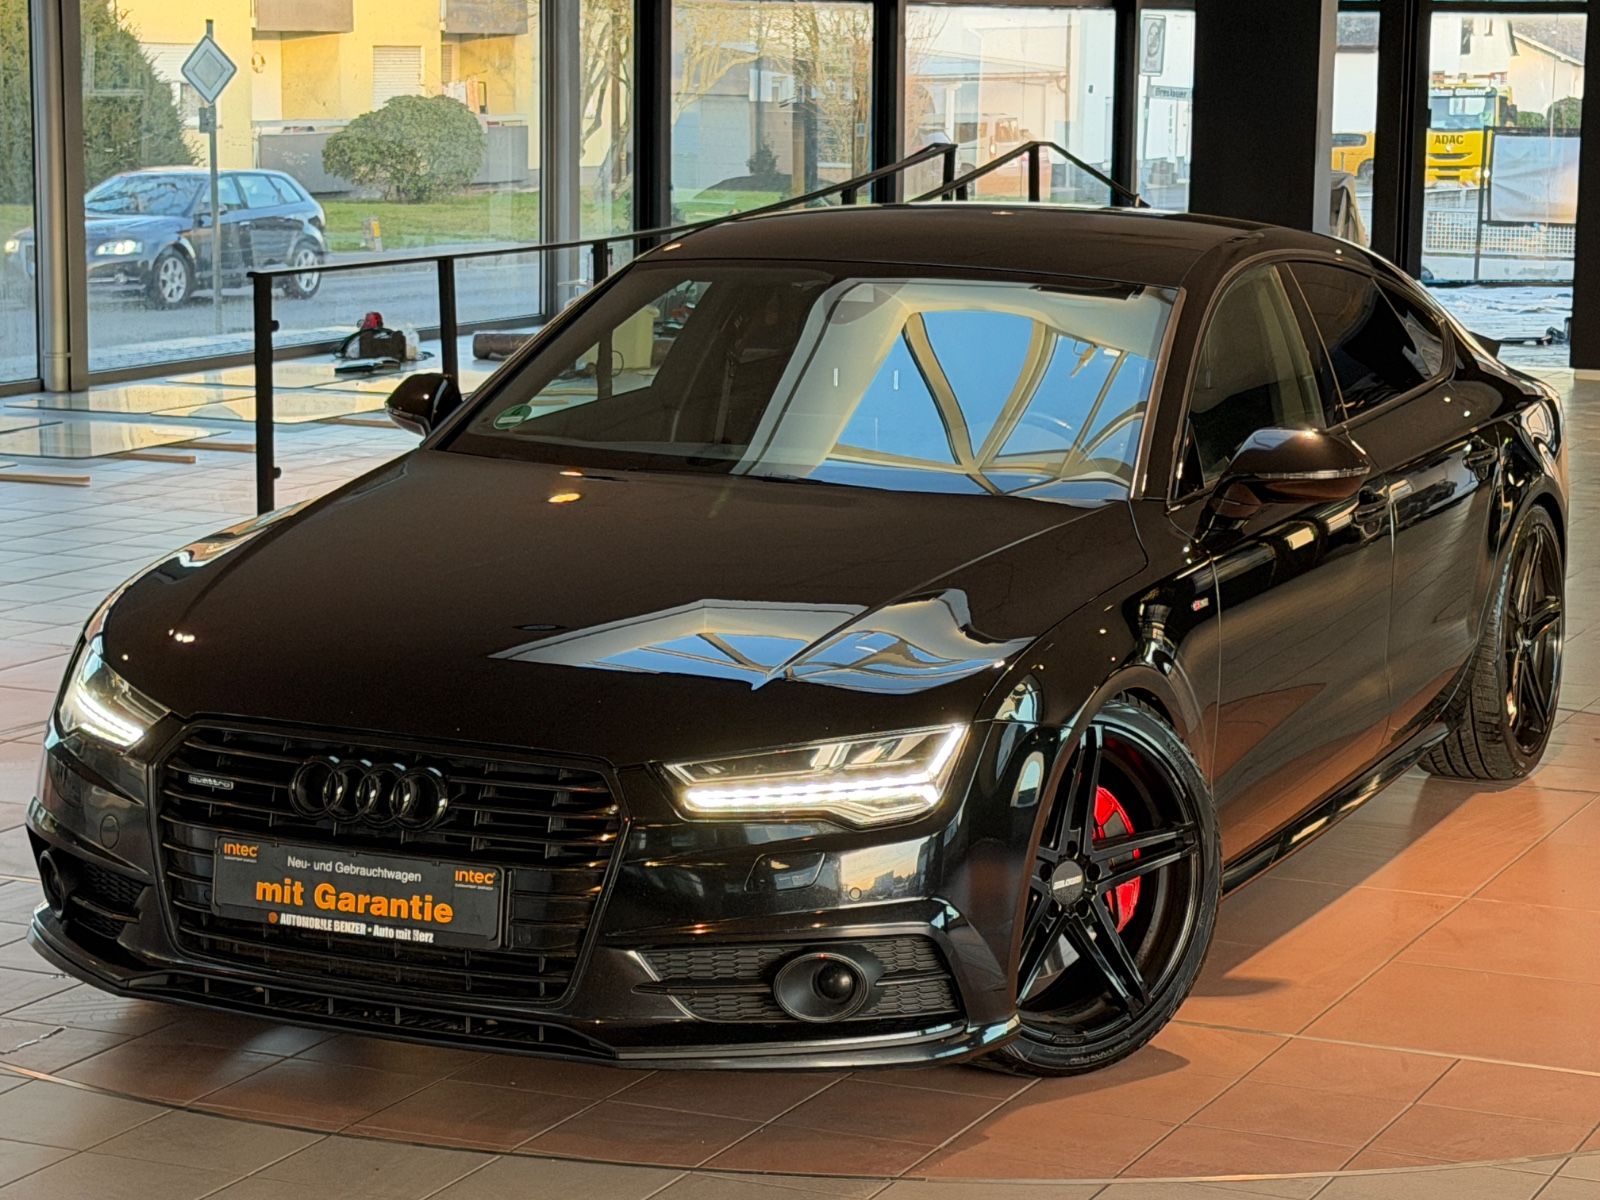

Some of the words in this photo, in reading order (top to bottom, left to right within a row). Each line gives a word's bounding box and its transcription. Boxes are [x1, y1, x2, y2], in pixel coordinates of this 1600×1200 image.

[1434, 134, 1464, 145] ADAC
[223, 843, 258, 858] intec
[287, 855, 311, 869] Neu-
[313, 860, 333, 873] und
[334, 861, 422, 883] Gebrauchtwagen
[454, 869, 495, 885] intec
[255, 878, 304, 906] mit
[313, 882, 454, 924] Garantie
[280, 912, 332, 931] AUTOMOBILE
[373, 924, 395, 939] Auto
[395, 928, 411, 941] mit
